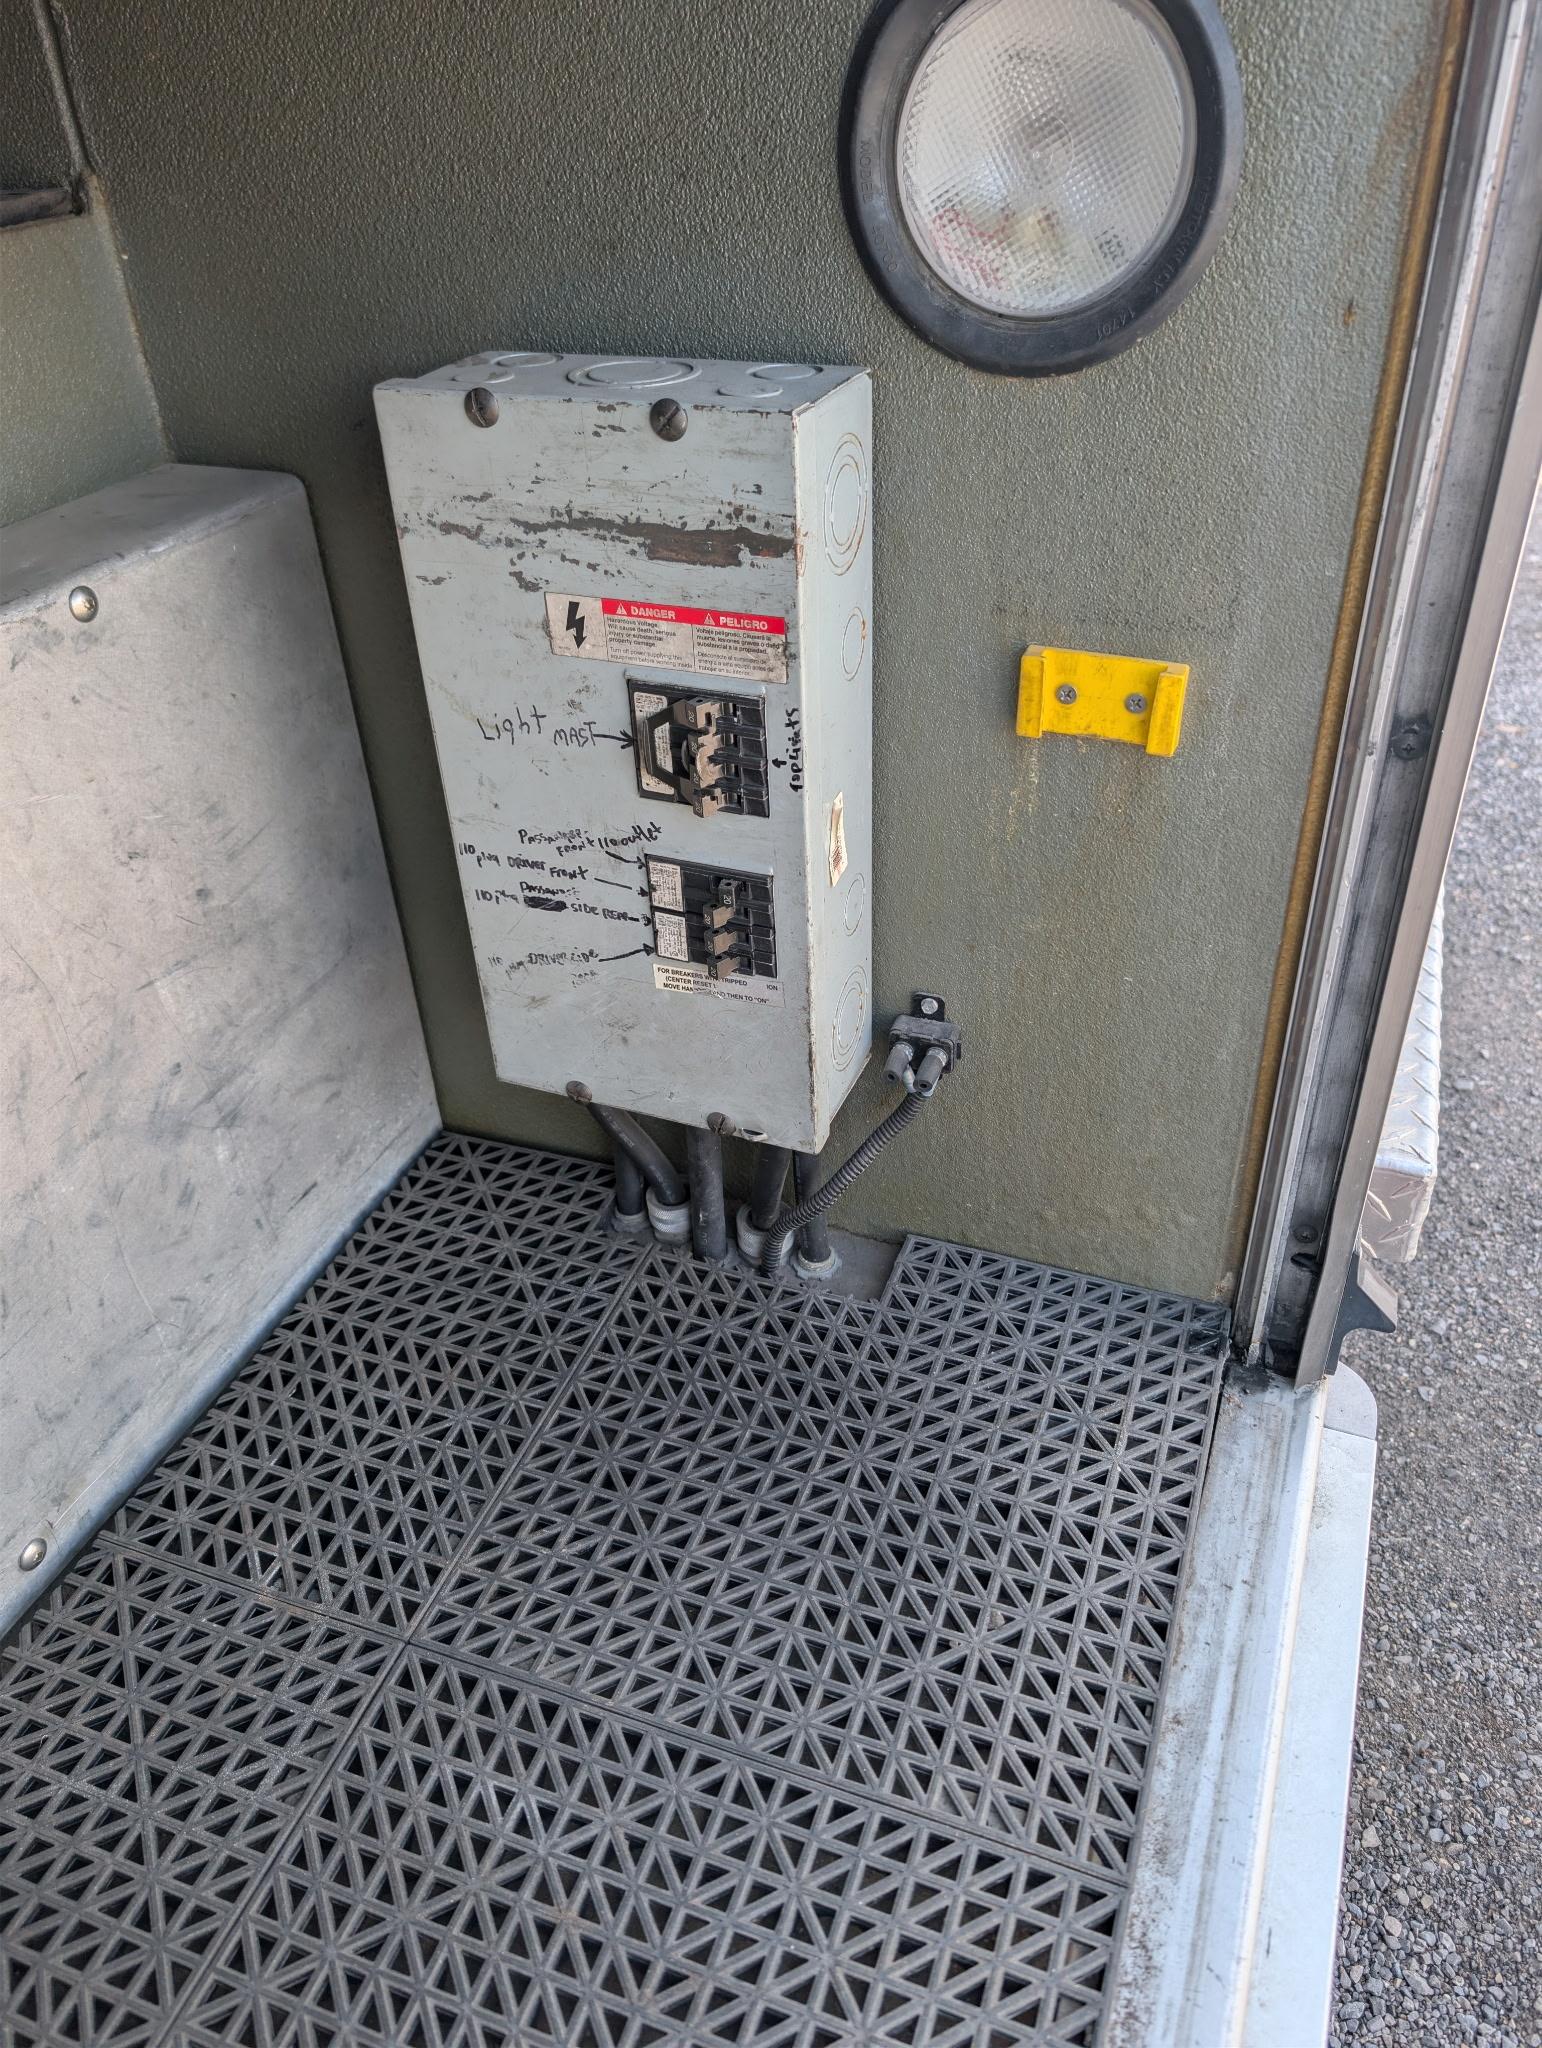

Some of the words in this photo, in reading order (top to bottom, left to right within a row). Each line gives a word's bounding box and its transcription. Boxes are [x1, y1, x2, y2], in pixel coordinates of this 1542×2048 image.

[630, 605, 676, 620] DANGER
[719, 616, 768, 630] PELIGRO
[608, 636, 632, 645] property
[632, 632, 664, 642] substantial
[477, 705, 547, 745] Light
[553, 721, 597, 748] MAST
[459, 842, 476, 856] 110
[475, 889, 493, 901] 110
[723, 894, 732, 905] 20
[657, 966, 670, 975] FOR
[671, 968, 705, 980] BREAKERS
[721, 977, 748, 987] TRIPPED
[665, 976, 692, 985] (CENTER
[693, 980, 713, 988] RESET
[663, 983, 681, 991] MOVE
[726, 992, 744, 1001] THEN
